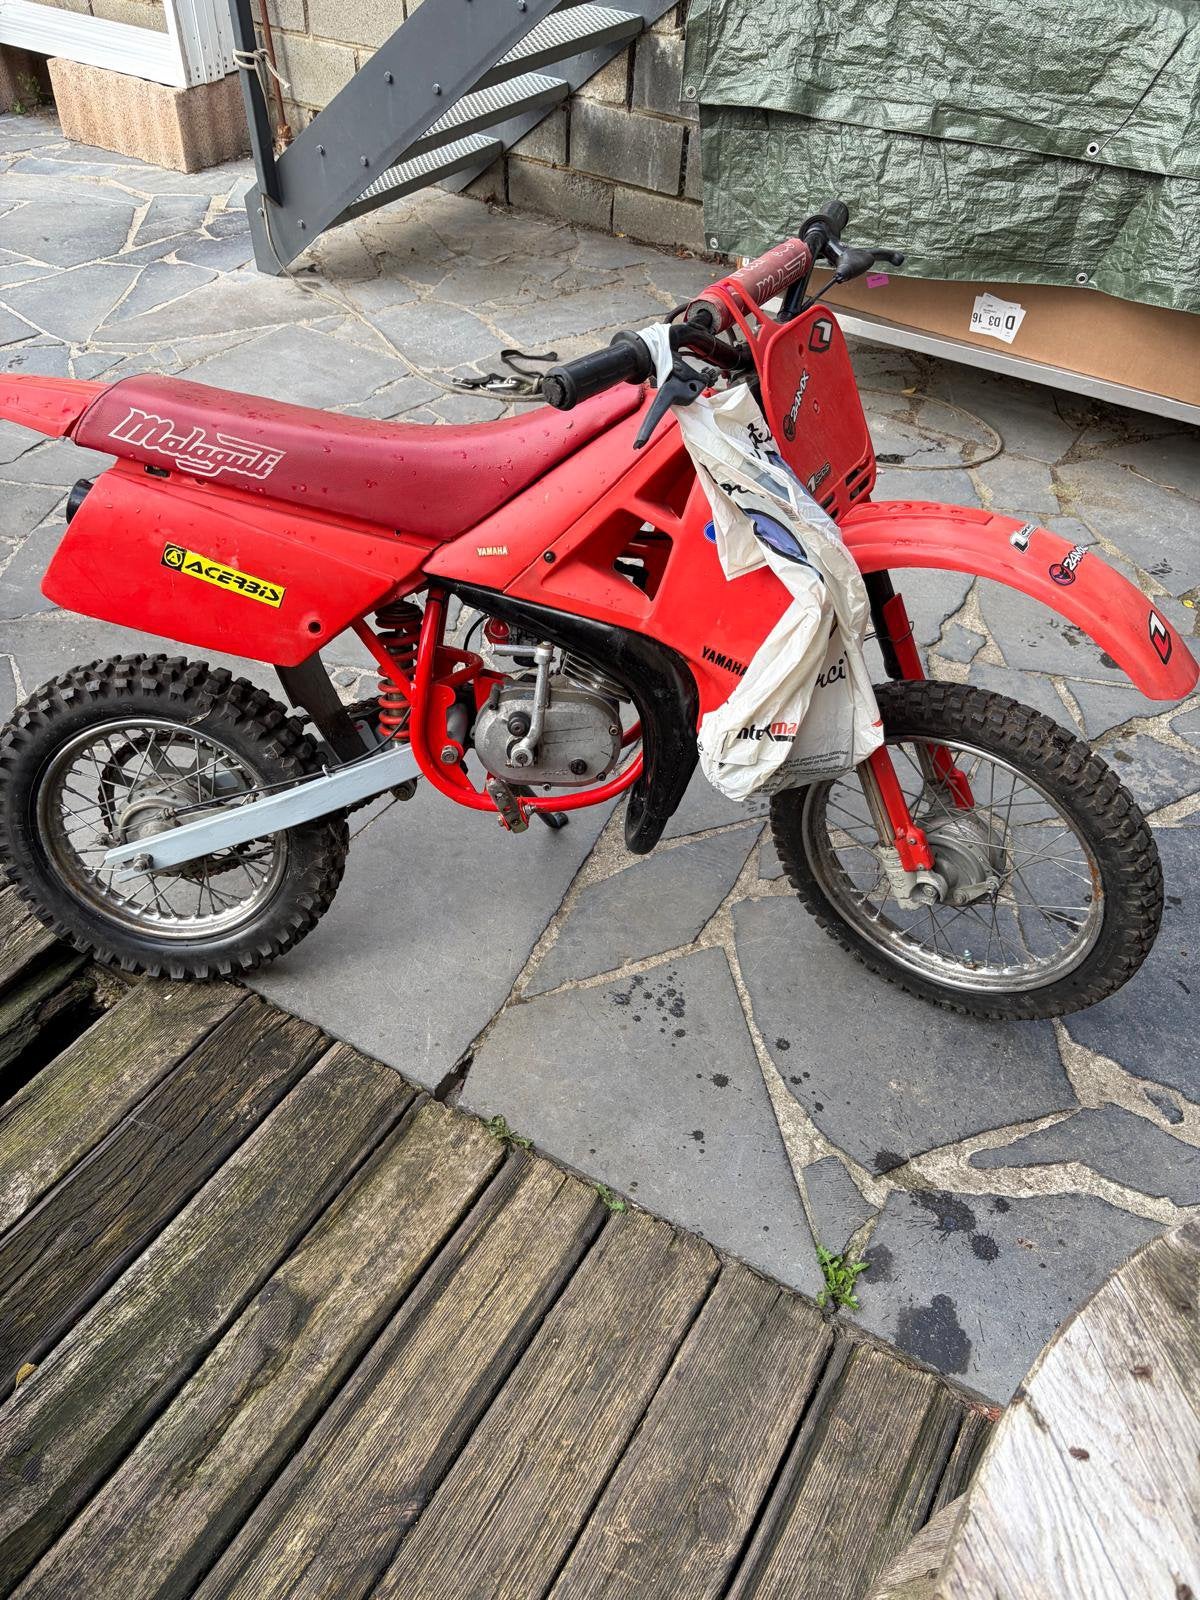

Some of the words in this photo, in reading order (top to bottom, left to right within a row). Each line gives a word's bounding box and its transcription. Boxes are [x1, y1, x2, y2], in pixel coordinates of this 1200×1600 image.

[972, 312, 983, 324] 16
[1005, 315, 1016, 330] D
[790, 368, 811, 423] 24MX
[108, 407, 287, 480] Malaguti
[476, 545, 508, 557] YAMAHA
[185, 561, 280, 601] ACERBIS
